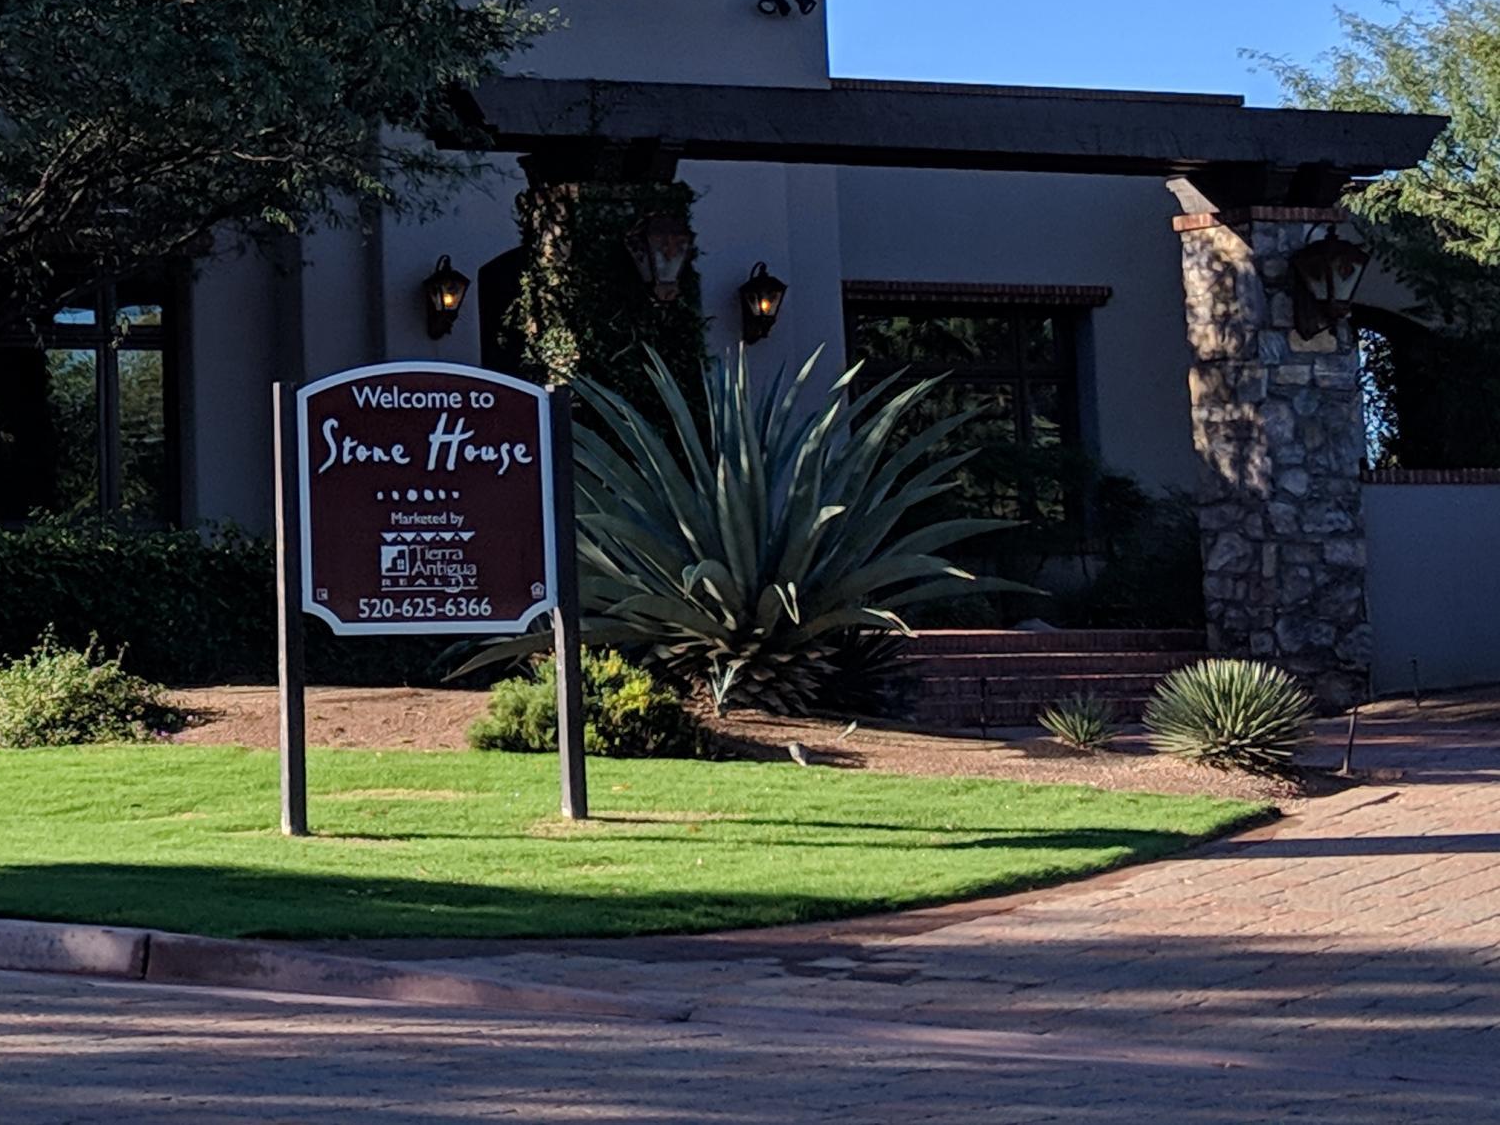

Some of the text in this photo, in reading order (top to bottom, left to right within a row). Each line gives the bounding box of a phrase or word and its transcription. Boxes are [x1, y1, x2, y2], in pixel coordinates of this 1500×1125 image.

[352, 385, 495, 409] Welcome to
[318, 412, 532, 474] Stone House
[390, 511, 465, 528] Marketed by
[409, 545, 464, 561] Tierra
[381, 577, 478, 587] REALTY
[359, 598, 492, 618] 520-625-6366
